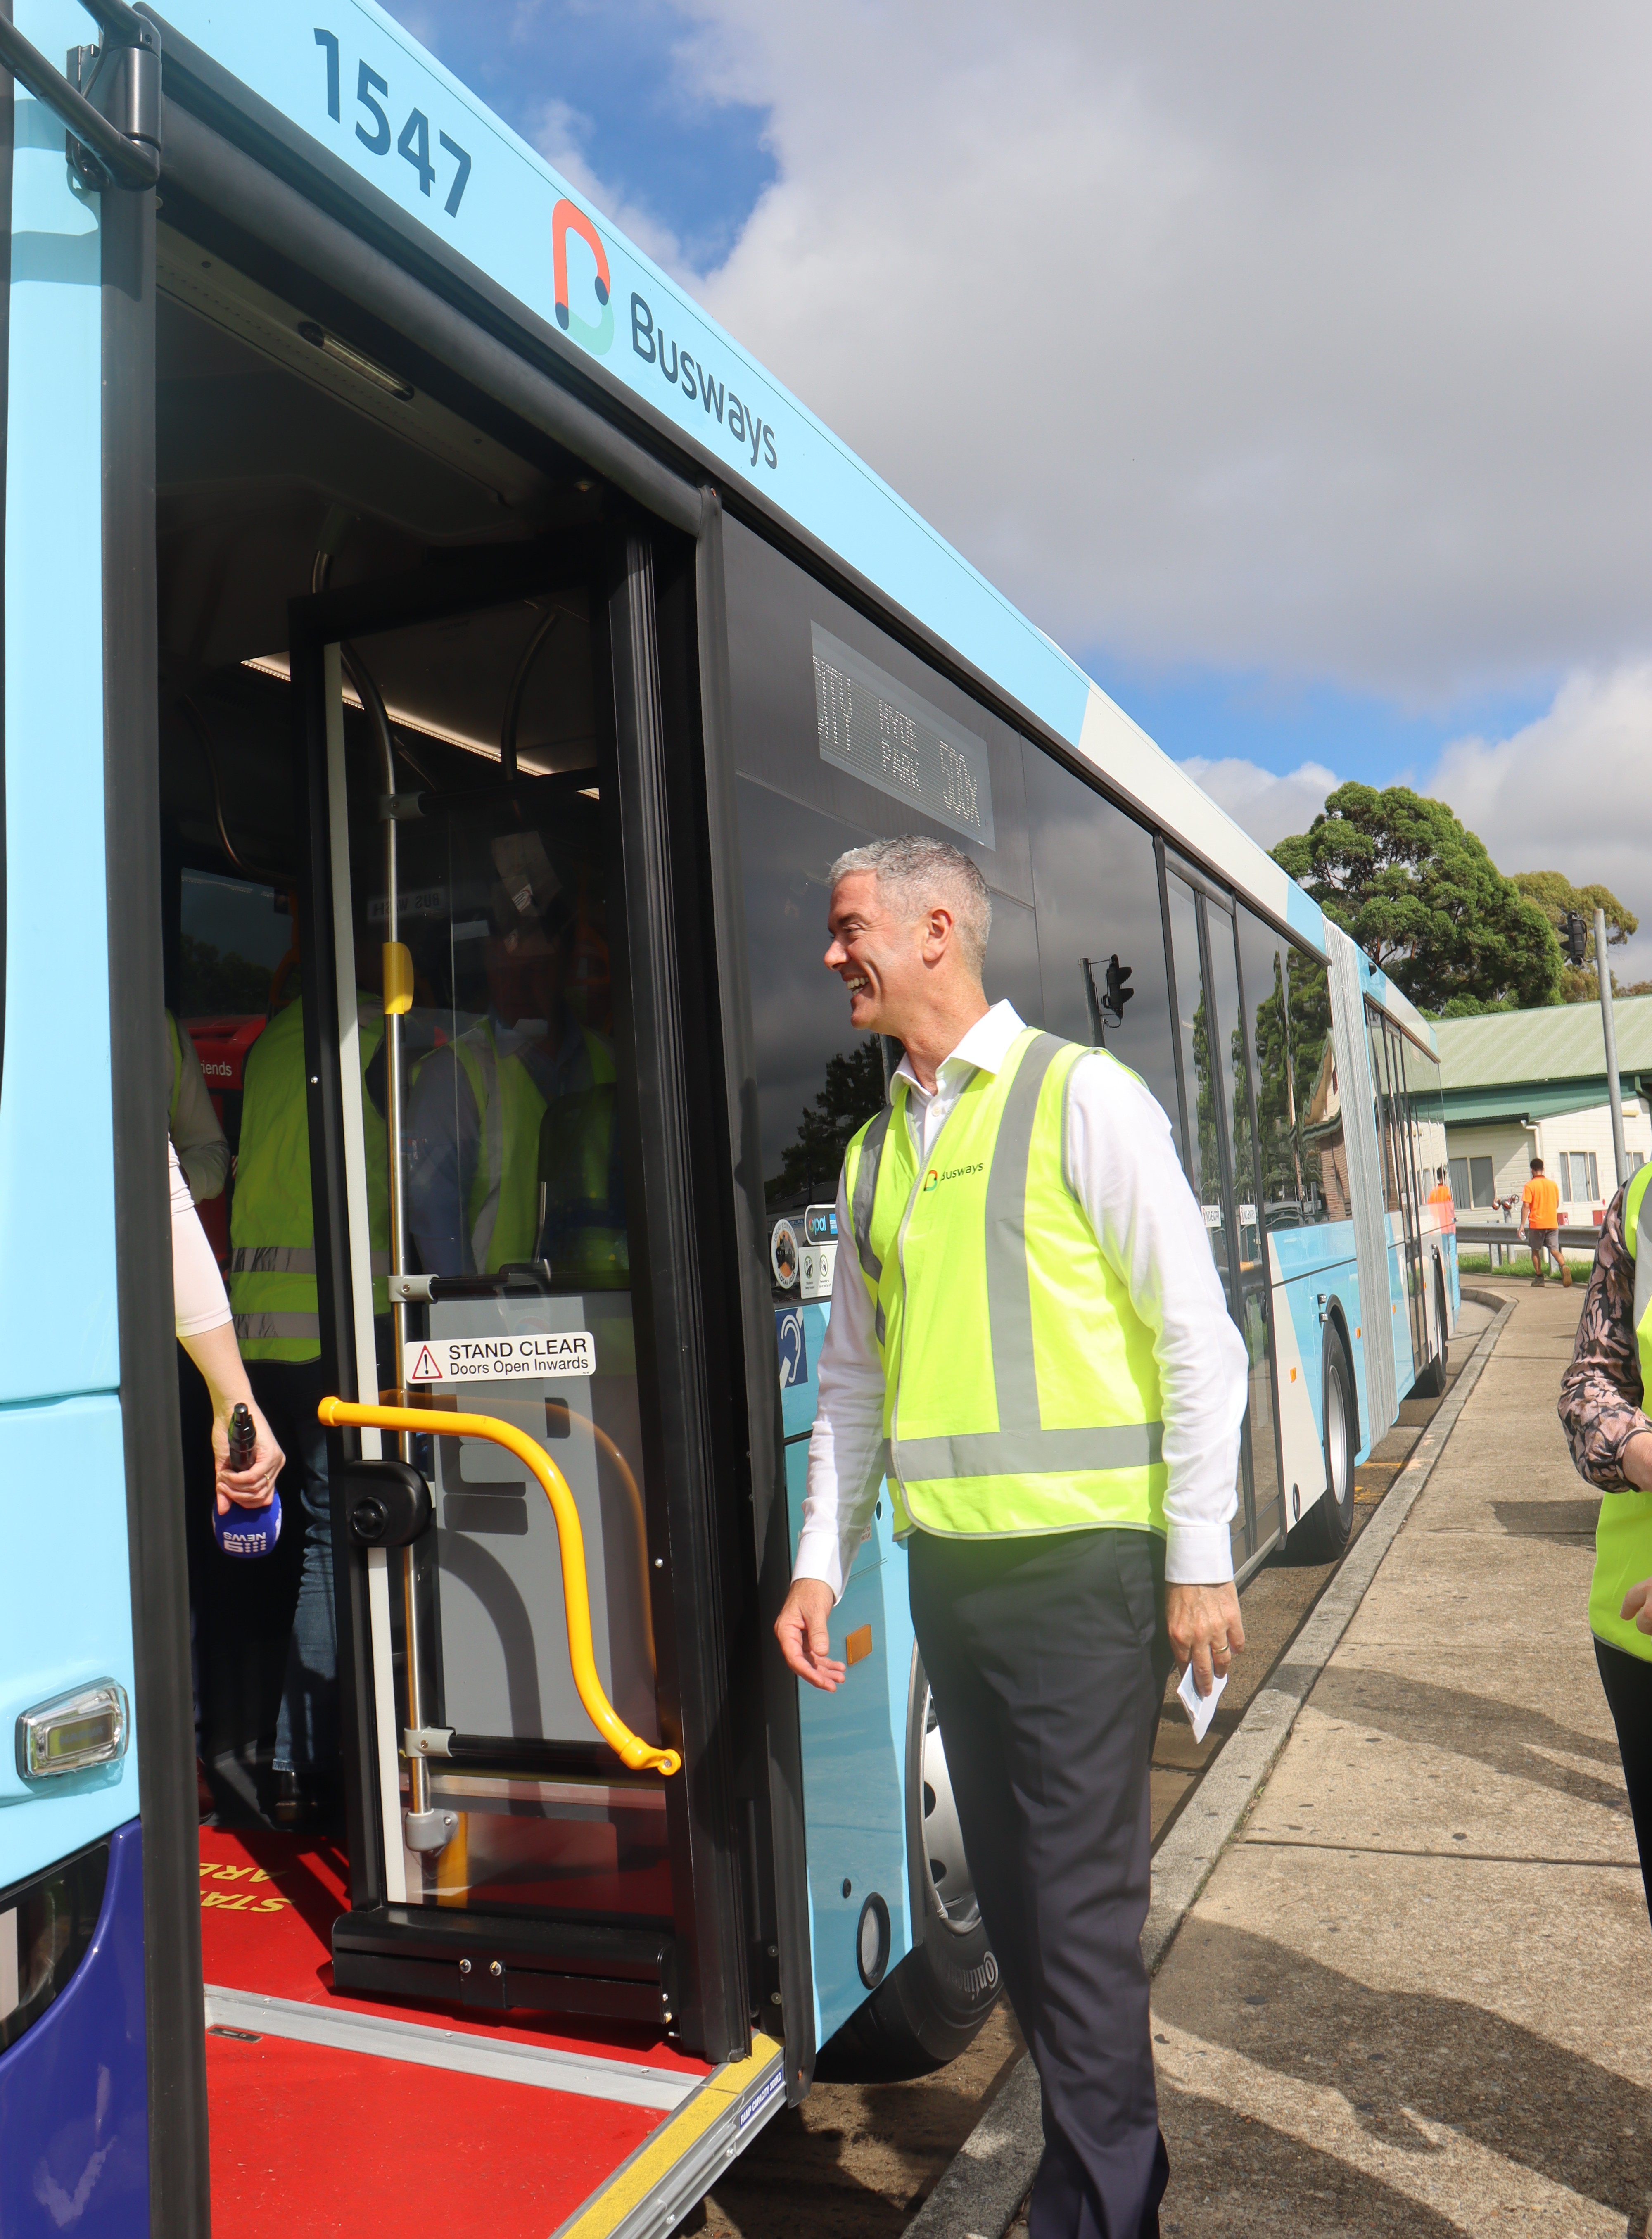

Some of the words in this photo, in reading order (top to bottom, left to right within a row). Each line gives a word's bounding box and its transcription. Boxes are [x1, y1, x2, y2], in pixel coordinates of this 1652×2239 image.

[313, 27, 472, 218] 1547
[631, 292, 778, 470] Busways
[878, 699, 919, 753] HYDE
[881, 740, 921, 792] PARK
[808, 1215, 826, 1235] opal
[1206, 1211, 1211, 1222] NO
[1244, 1211, 1248, 1219] NO
[449, 1342, 513, 1360] STAND
[519, 1338, 587, 1356] CLEAR
[450, 1362, 489, 1375] Doors
[494, 1360, 529, 1375] Open
[534, 1356, 589, 1371] Inwards
[223, 1531, 266, 1542] NEWS
[200, 1890, 295, 1913] STA
[741, 2105, 752, 2125] RAMP
[752, 2084, 769, 2111] CAPACITY
